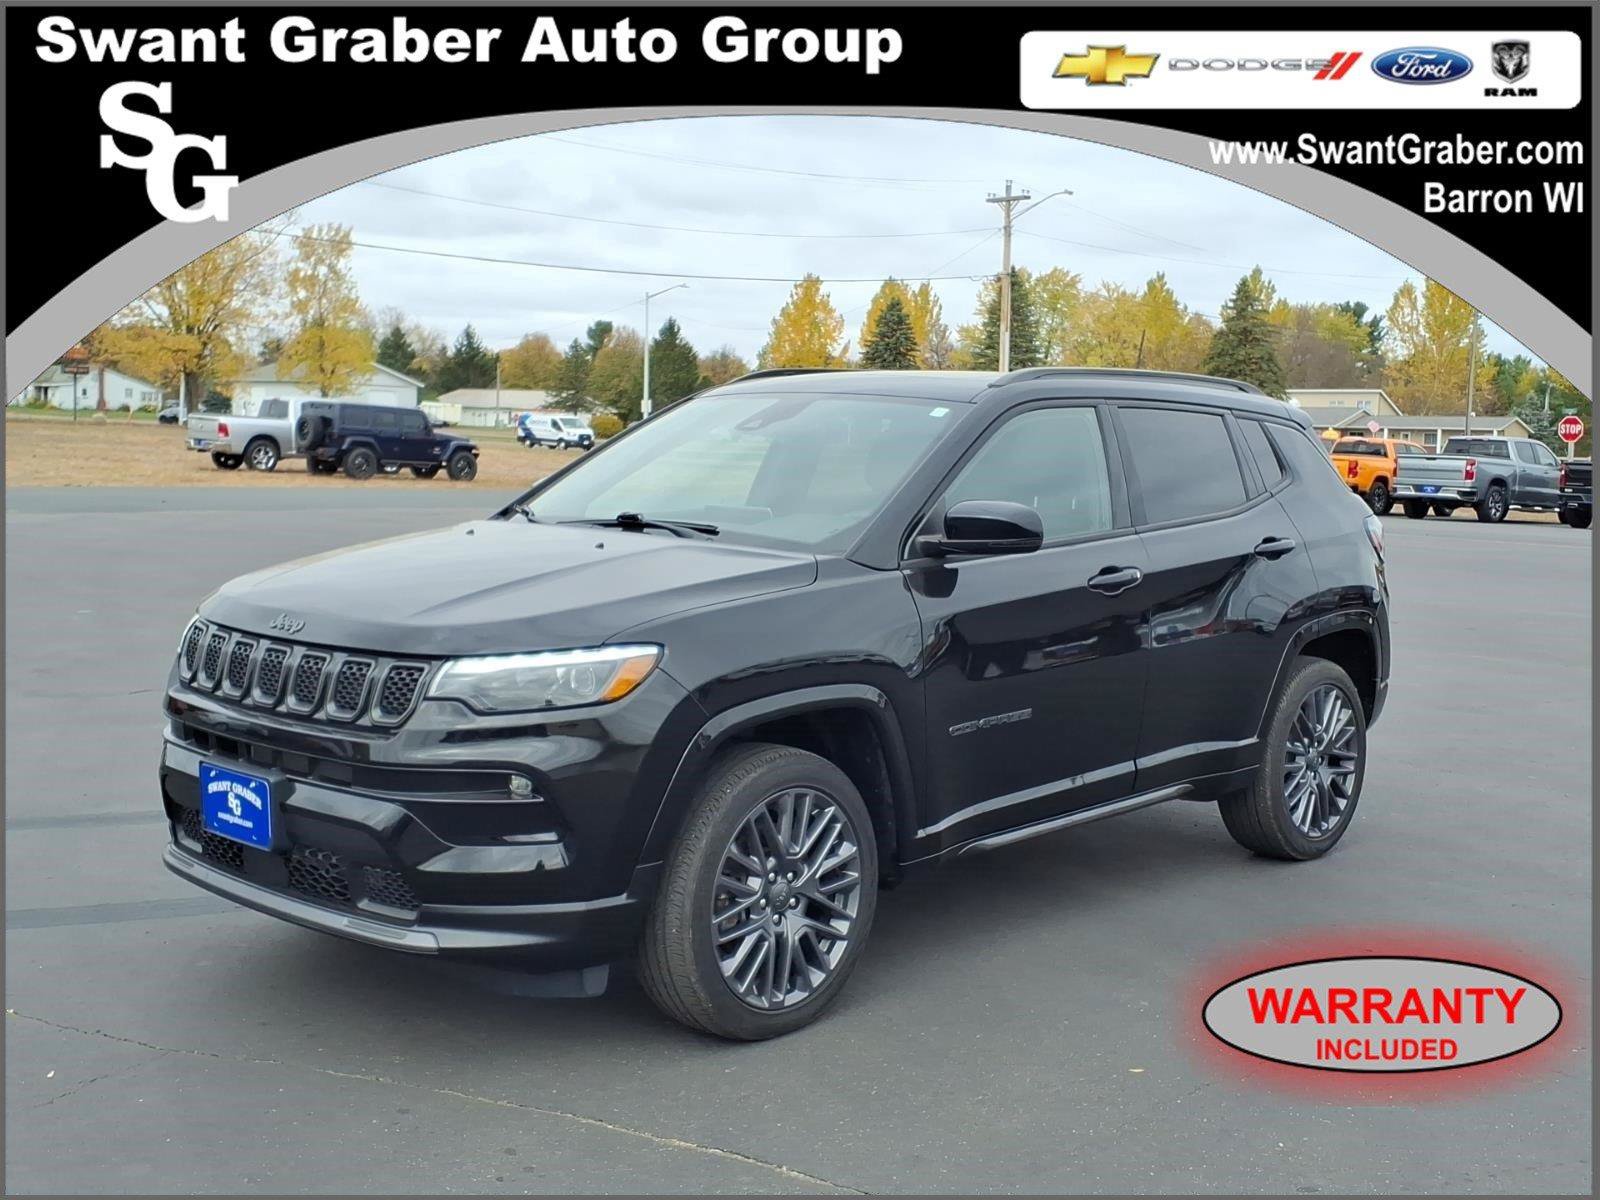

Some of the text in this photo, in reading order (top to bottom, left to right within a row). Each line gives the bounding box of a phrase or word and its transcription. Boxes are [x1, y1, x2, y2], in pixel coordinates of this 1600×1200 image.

[1560, 424, 1581, 435] STOP
[270, 613, 306, 635] Jeep
[949, 707, 1033, 736] COMPASS
[208, 780, 262, 810] SWANT GRABER
